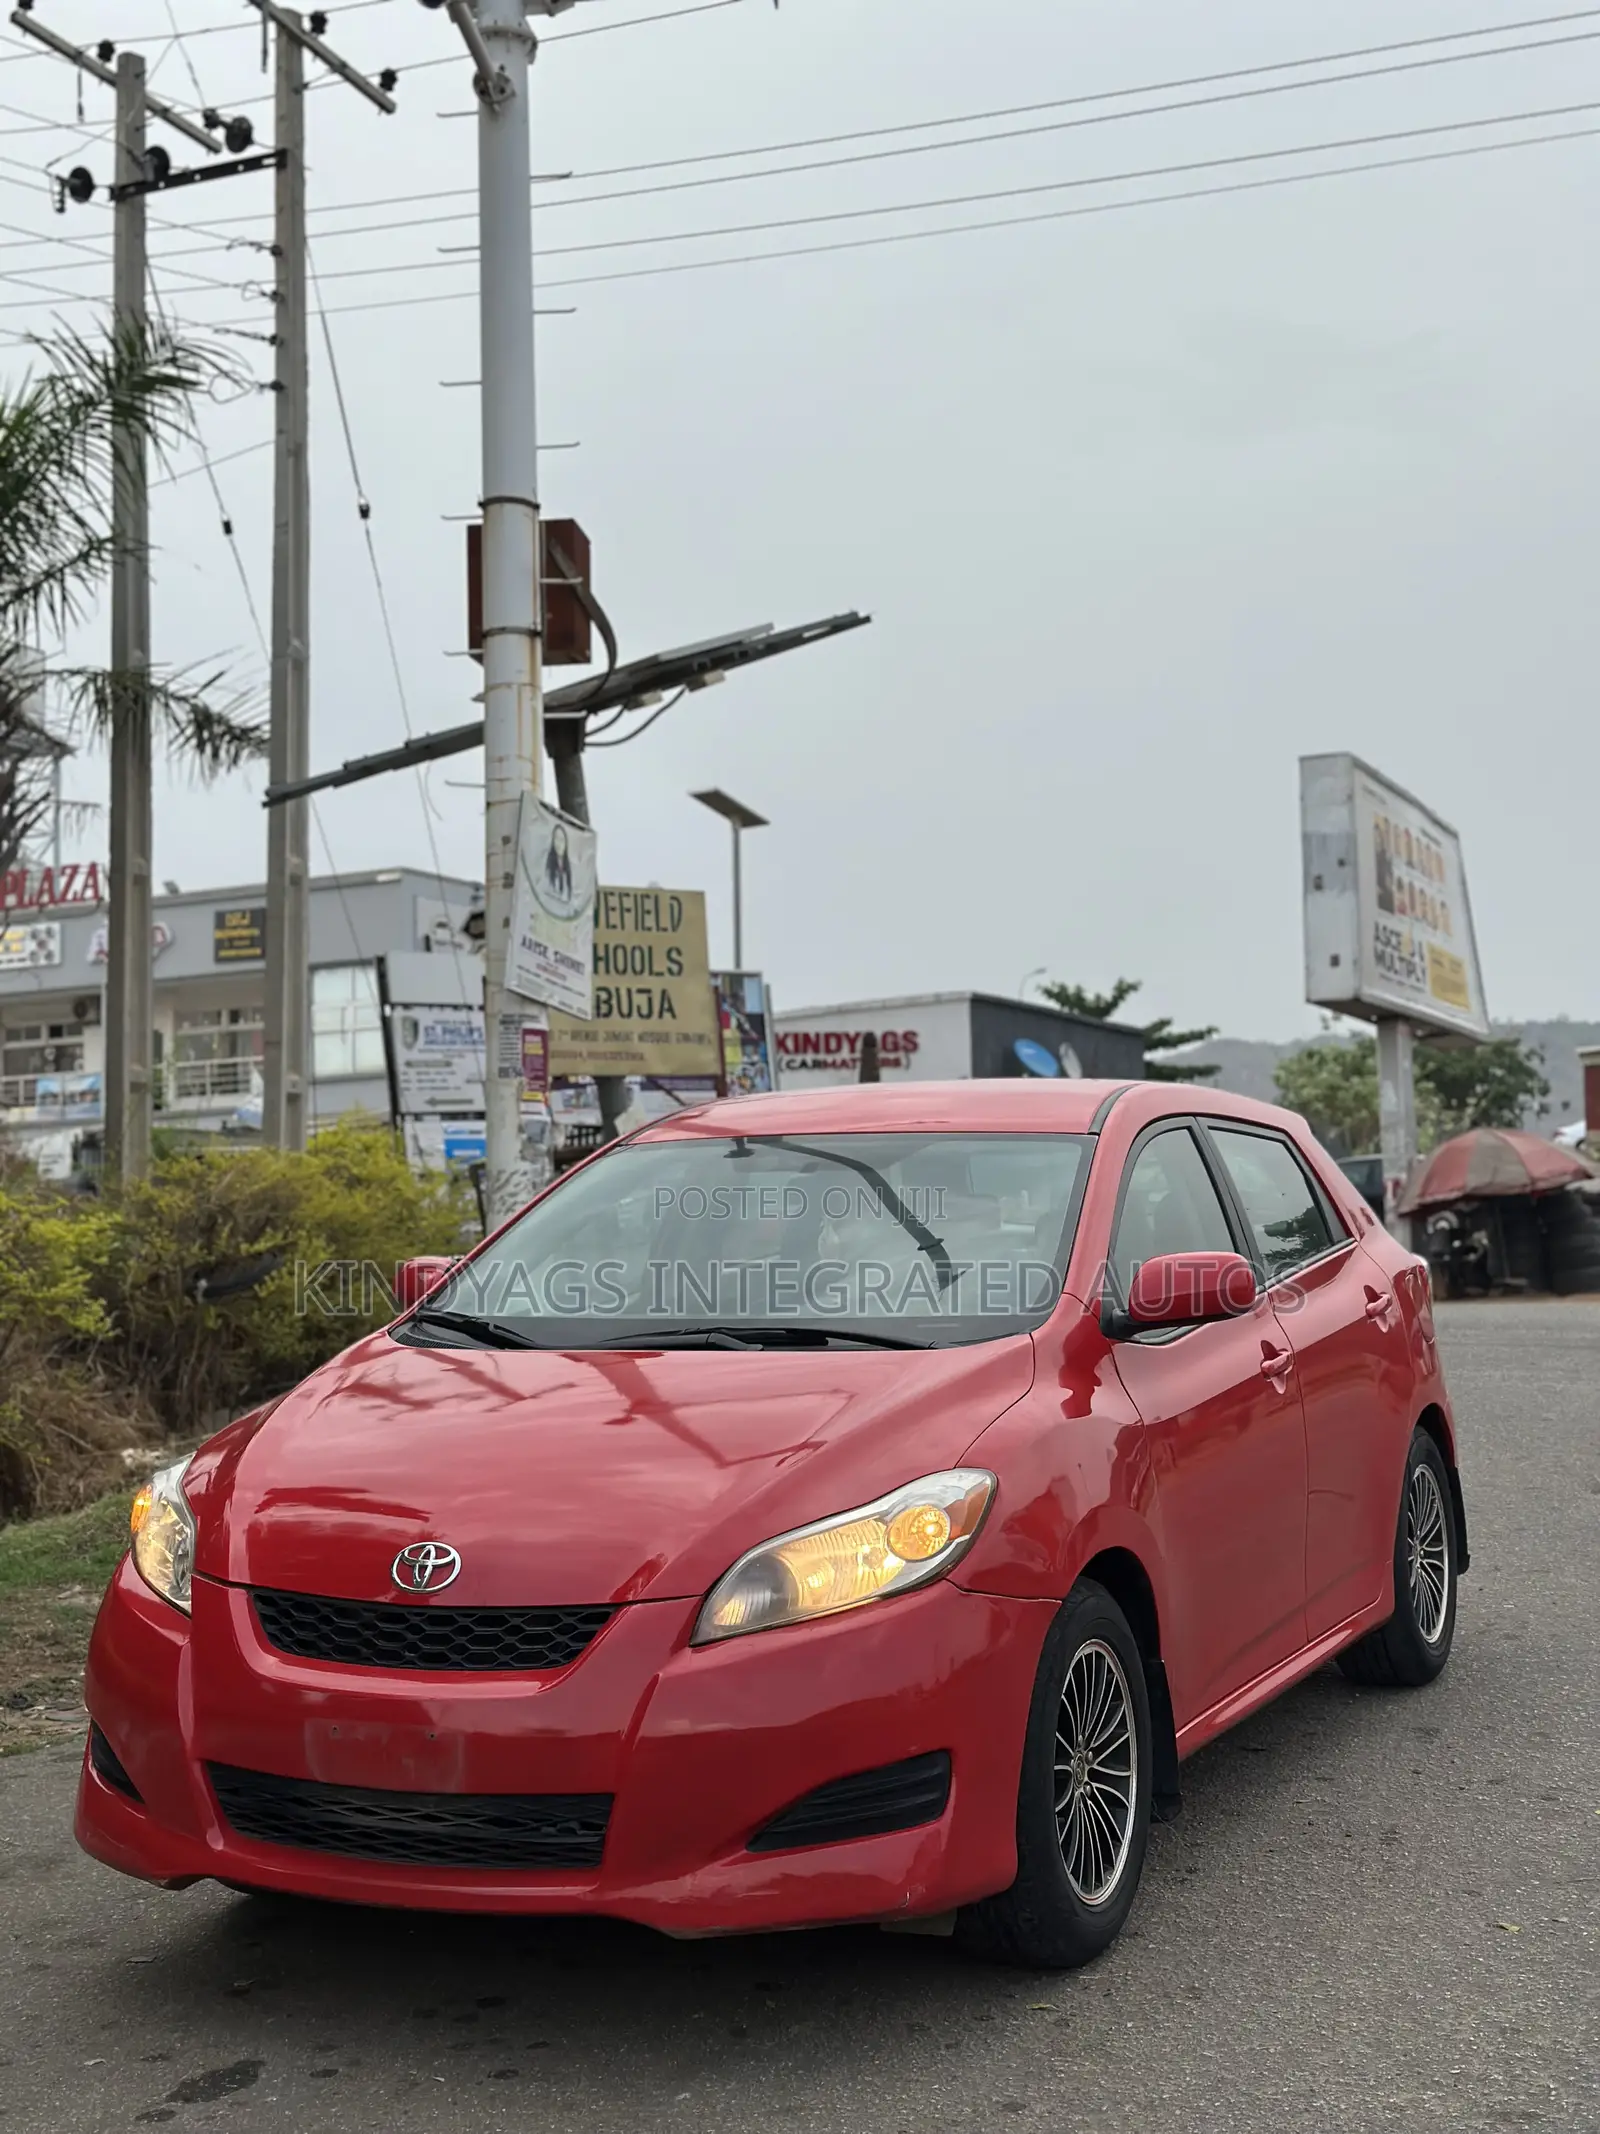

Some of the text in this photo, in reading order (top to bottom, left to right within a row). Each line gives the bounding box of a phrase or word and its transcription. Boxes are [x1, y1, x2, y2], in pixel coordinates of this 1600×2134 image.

[0, 861, 100, 910] PLAZA
[593, 943, 683, 976] HOOLS
[596, 986, 677, 1020] BUJA
[774, 1030, 919, 1055] KINDYGS
